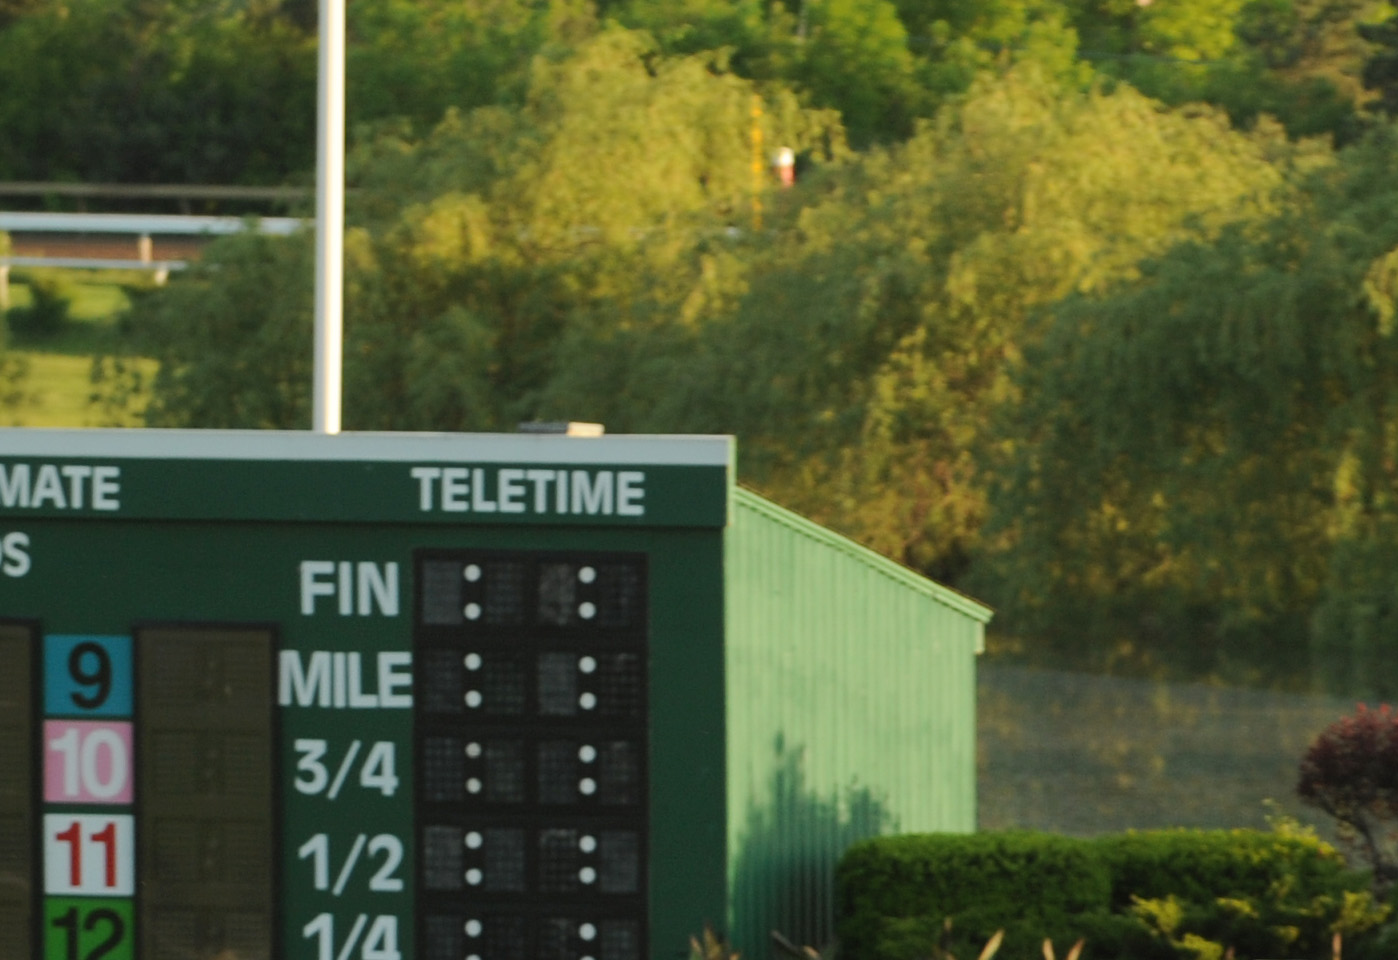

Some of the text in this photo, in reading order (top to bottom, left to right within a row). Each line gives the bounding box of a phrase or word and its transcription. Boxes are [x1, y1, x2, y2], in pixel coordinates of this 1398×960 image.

[411, 467, 645, 516] TELETIME
[0, 531, 31, 577] S
[299, 560, 399, 617] FIN
[67, 642, 112, 710] 9
[278, 649, 413, 709] MILE
[49, 728, 127, 799] 10
[294, 738, 398, 799] 3/4
[55, 822, 117, 888] 11
[298, 833, 403, 895] 1/2
